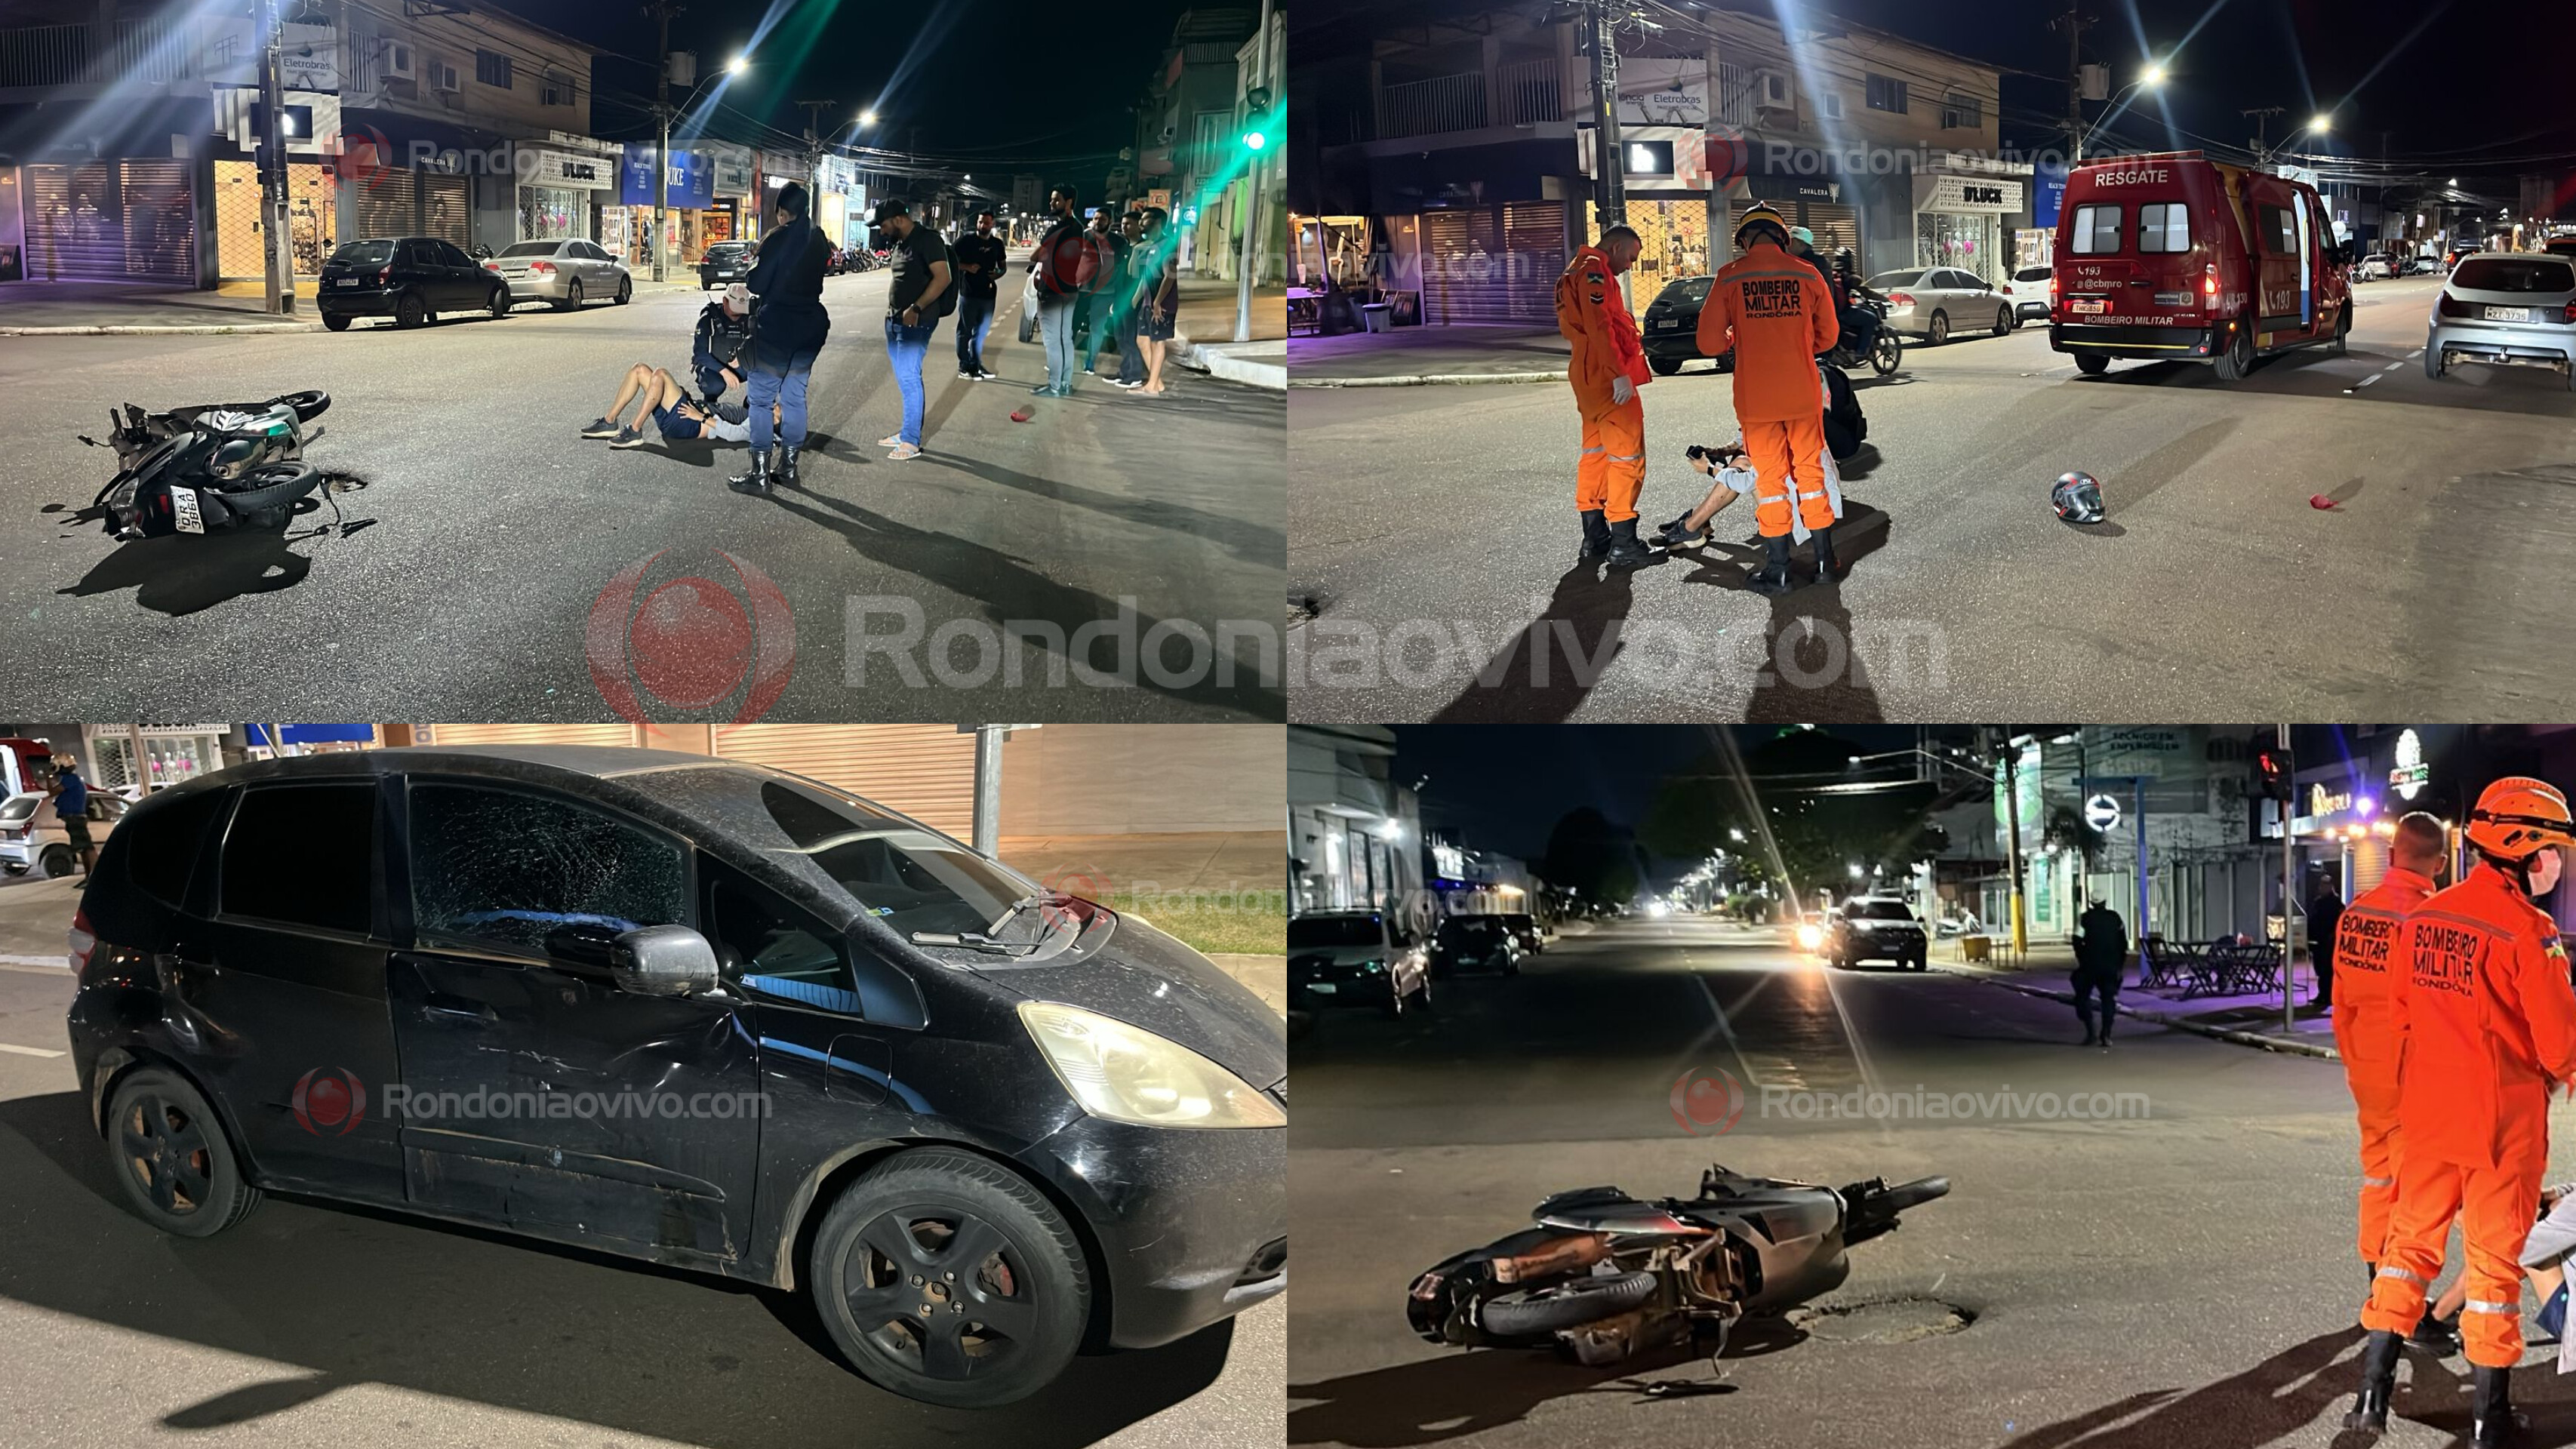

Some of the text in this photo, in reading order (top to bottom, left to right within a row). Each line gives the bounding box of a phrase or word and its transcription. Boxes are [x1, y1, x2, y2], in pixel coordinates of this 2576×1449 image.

[284, 58, 331, 70] Eletrobras
[1654, 94, 1701, 103] Eletrobras
[421, 156, 446, 165] CAVALERA
[668, 167, 685, 186] UKE
[2095, 169, 2168, 187] RESGATE
[1799, 187, 1828, 196] CAVALERA
[2085, 266, 2101, 275] 193
[1742, 279, 1800, 297] BOMBEIRO
[2084, 278, 2122, 289] @cbmro
[1745, 295, 1801, 312] MILITAR
[2276, 290, 2290, 310] 193
[2085, 315, 2174, 325] BOMBEIRO MILITAR
[186, 494, 202, 529] 3860
[2339, 934, 2390, 961] MILITAR
